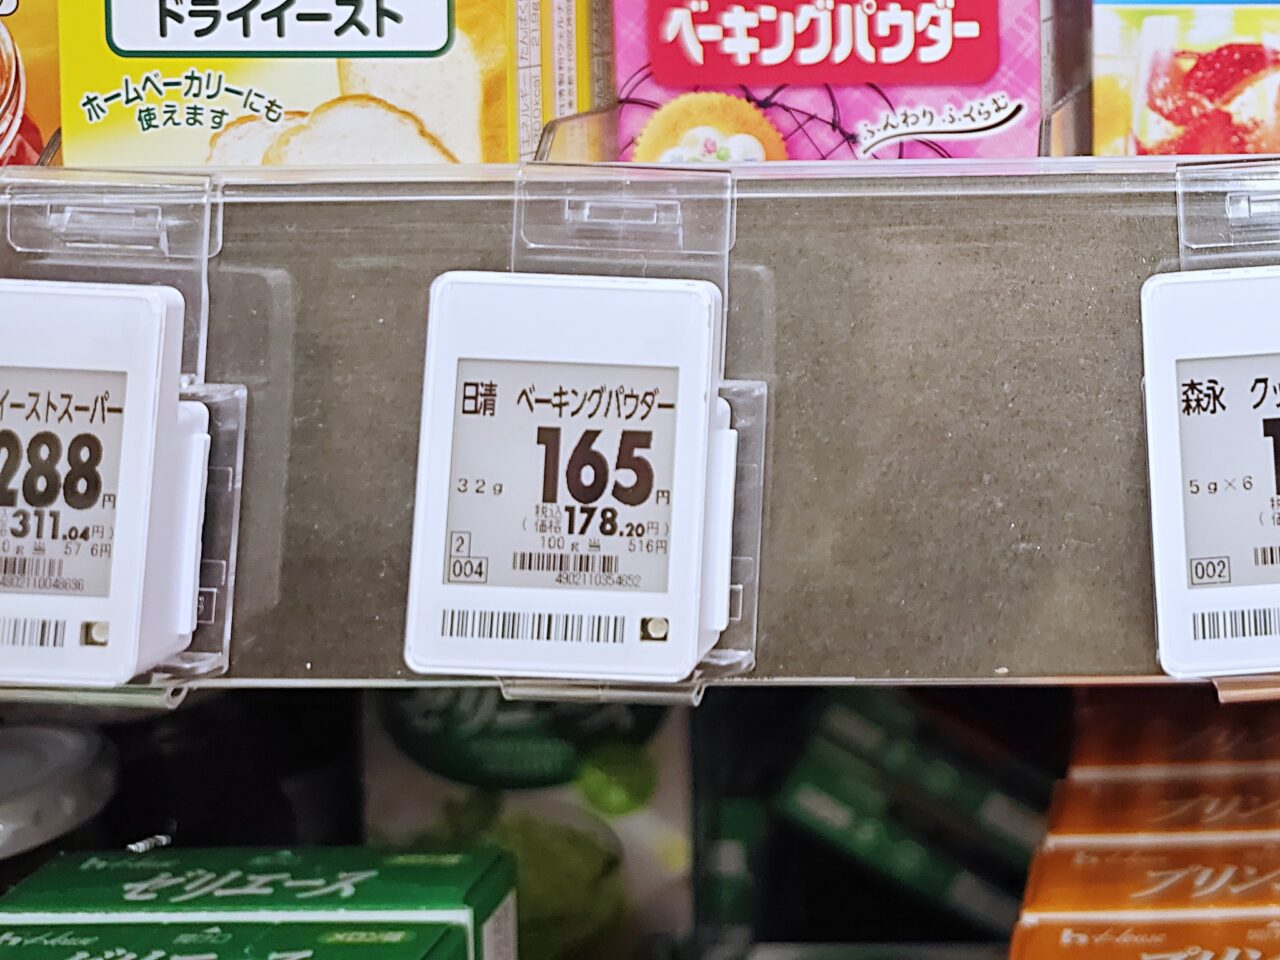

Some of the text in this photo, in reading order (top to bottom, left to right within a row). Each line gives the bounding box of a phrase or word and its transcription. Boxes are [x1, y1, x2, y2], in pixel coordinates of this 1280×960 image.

[81, 69, 284, 123] ホームベーカリーにも
[136, 104, 229, 133] 使えます
[462, 381, 675, 421] 日清 ベーキングパウダー
[1181, 378, 1227, 416] 森永
[455, 536, 465, 553] 2
[452, 560, 484, 578] 004
[1194, 560, 1227, 580] 002
